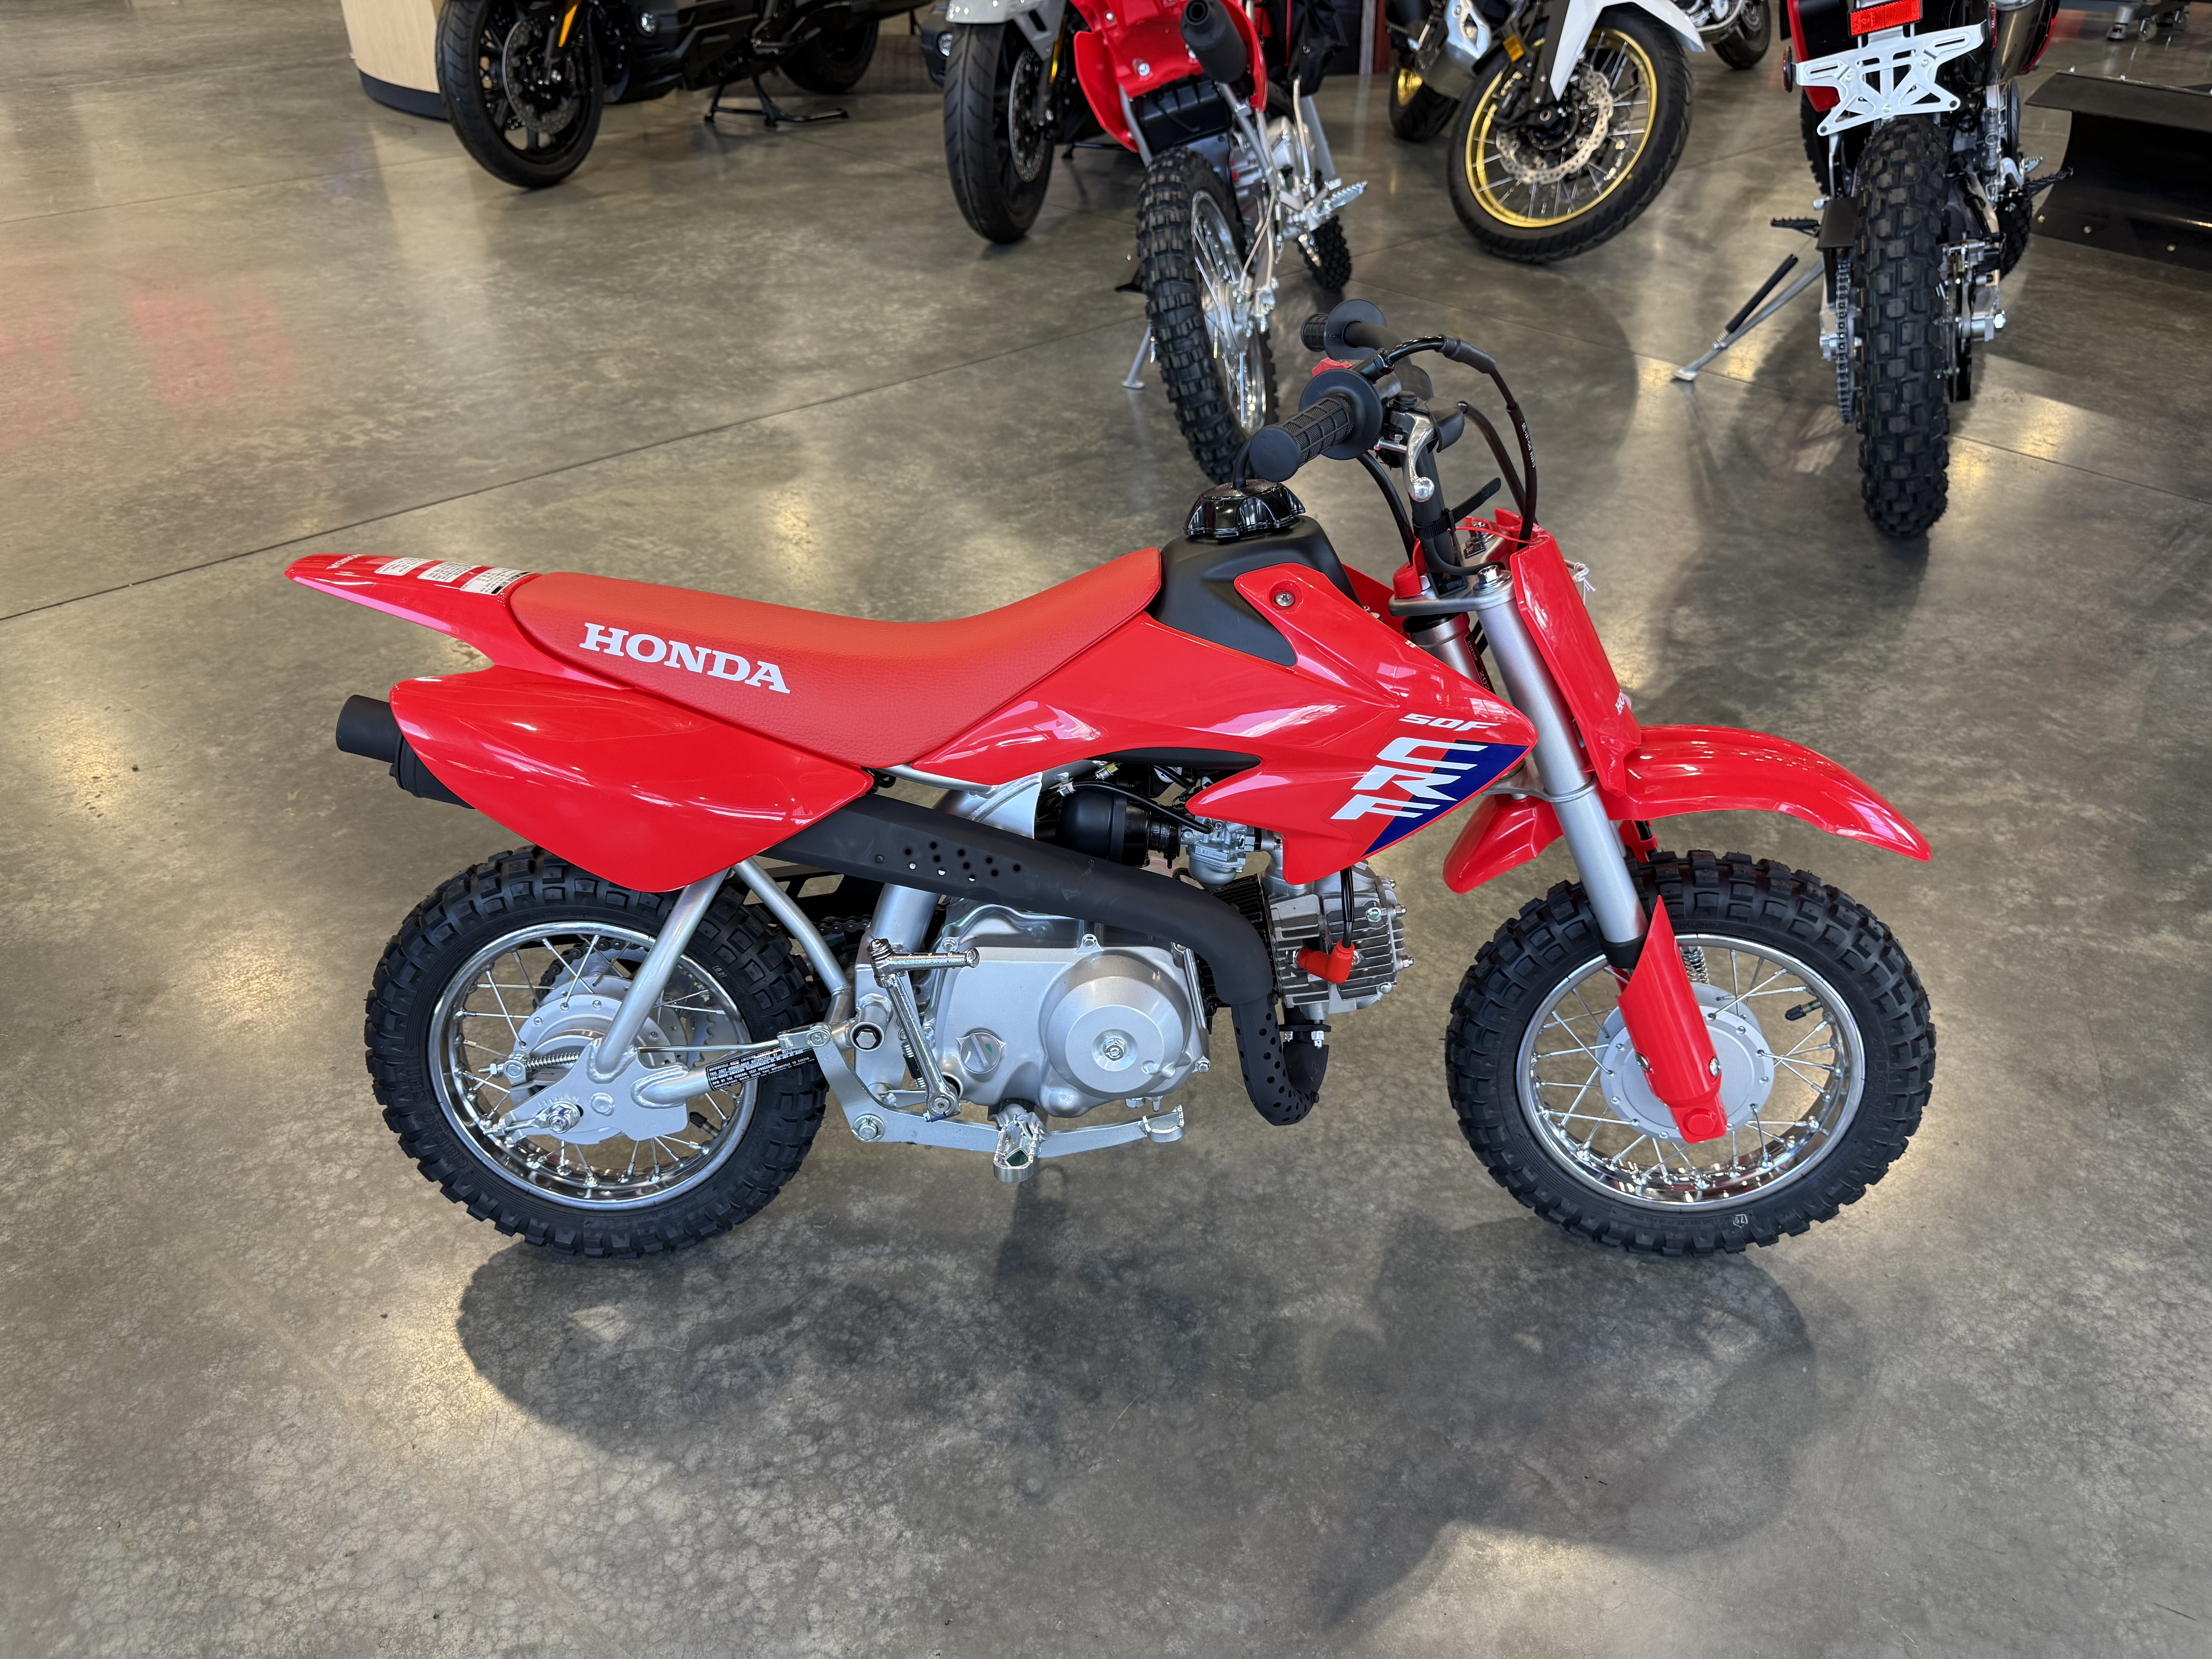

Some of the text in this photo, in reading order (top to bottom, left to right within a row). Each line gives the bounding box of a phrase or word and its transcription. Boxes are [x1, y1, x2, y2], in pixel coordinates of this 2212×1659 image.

[325, 554, 368, 570] HONDA
[579, 622, 791, 694] HONDA
[1398, 713, 1502, 731] 50F
[1330, 737, 1488, 819] CRF
